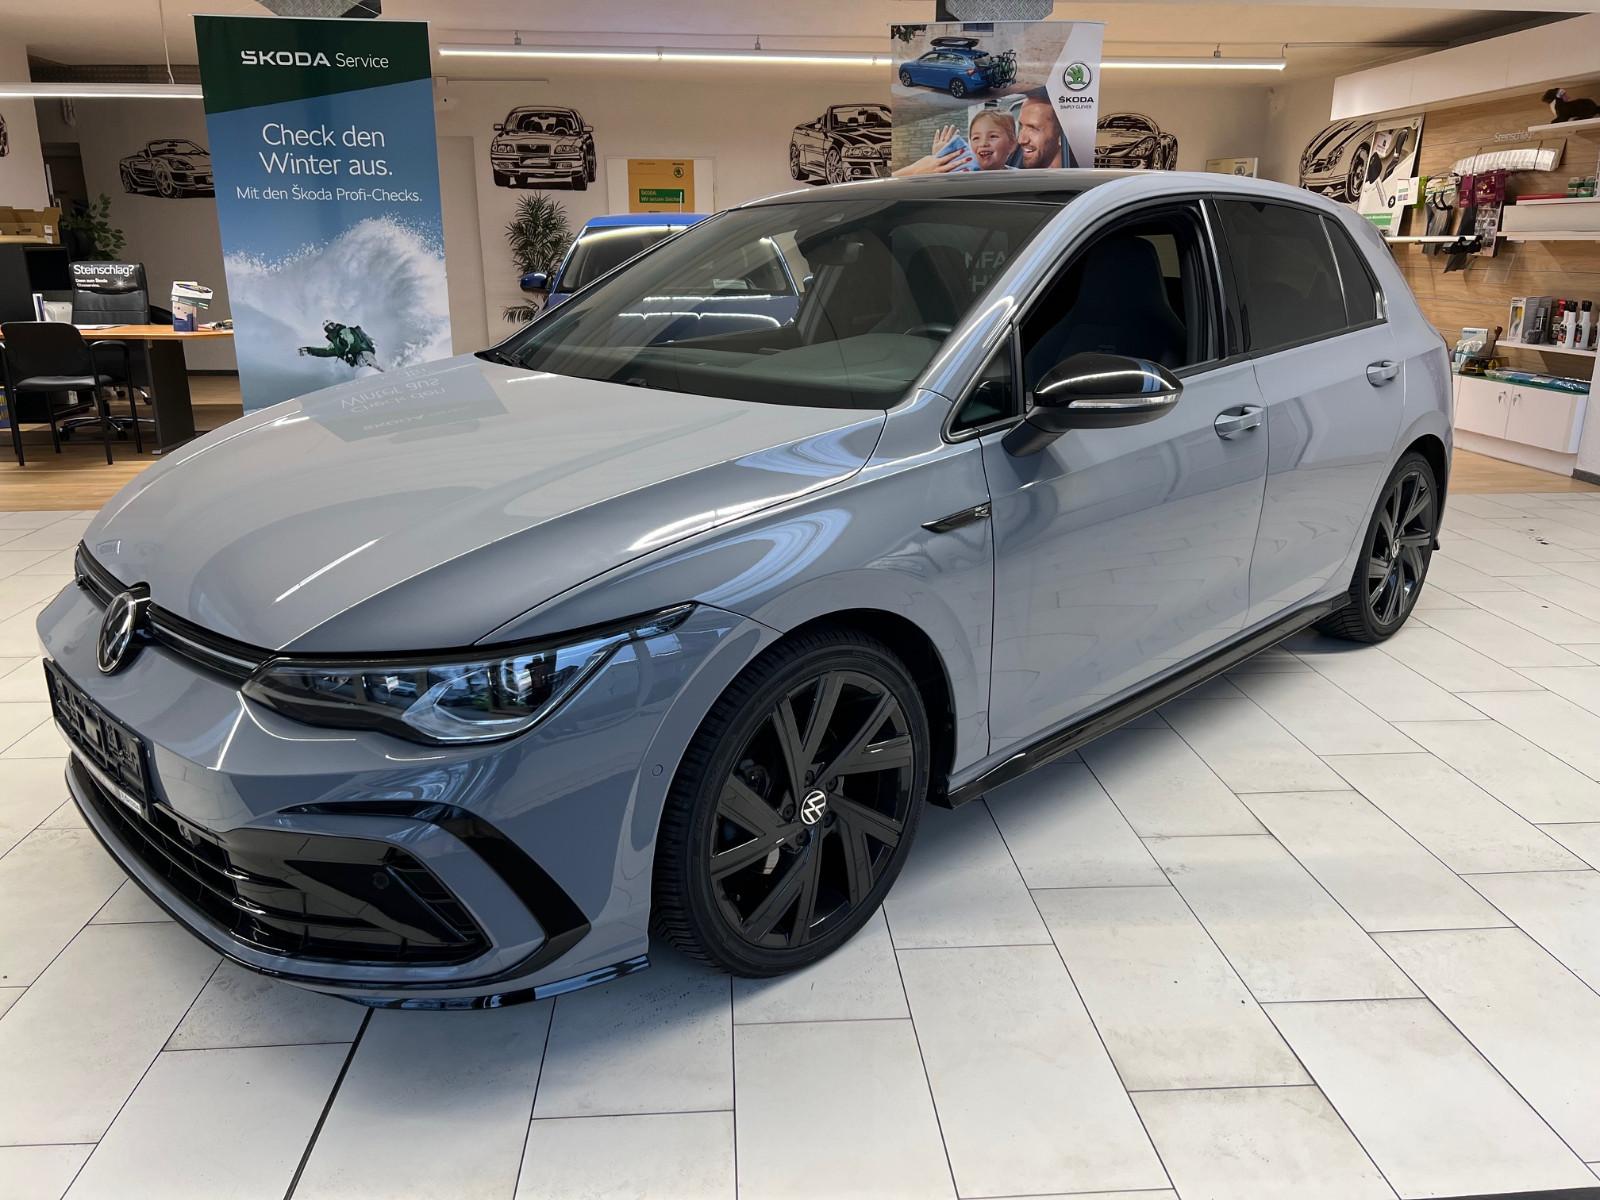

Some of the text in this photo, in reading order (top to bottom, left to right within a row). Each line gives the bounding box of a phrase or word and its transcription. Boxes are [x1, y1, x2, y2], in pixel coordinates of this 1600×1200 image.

[335, 53, 389, 68] Service
[262, 123, 385, 147] Check den
[259, 152, 393, 175] Winter aus.
[236, 184, 422, 202] Mit den Škoda Profi-Checks.
[73, 264, 135, 277] Steinschlag?
